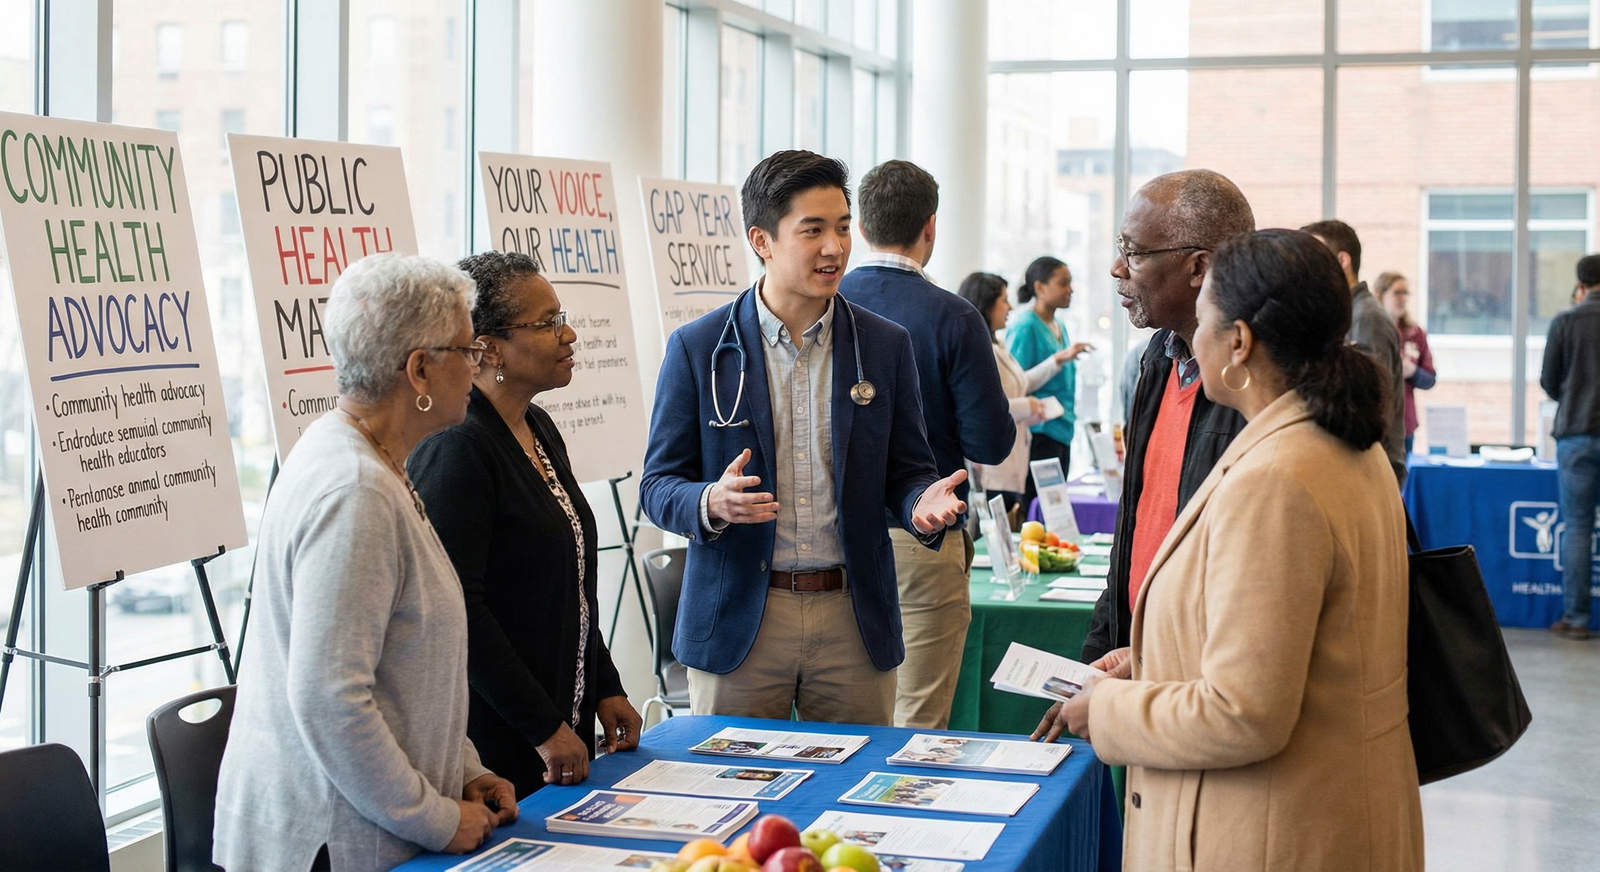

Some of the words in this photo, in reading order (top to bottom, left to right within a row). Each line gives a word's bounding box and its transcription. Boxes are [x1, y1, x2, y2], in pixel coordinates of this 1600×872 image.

[1, 129, 177, 214] COMMUNITY
[256, 150, 376, 216] PUBLIC
[488, 164, 548, 214] YOUR
[549, 169, 613, 223] VOICE,
[650, 188, 685, 234] GAP
[688, 191, 737, 238] YEAR
[45, 219, 170, 284] HEALTH
[549, 227, 620, 275] HEALTH
[668, 242, 737, 287] SERVICE
[48, 290, 192, 362] ADVOCACY
[52, 386, 118, 419] Community
[121, 382, 157, 408] health
[161, 380, 206, 406] advocacy
[57, 426, 114, 452] Endroduce
[162, 410, 213, 437] community
[79, 448, 115, 473] health
[118, 443, 167, 465] educators
[67, 483, 124, 508] Perntanose
[128, 471, 160, 494] animal
[163, 459, 217, 487] community
[76, 507, 112, 533] health
[115, 494, 169, 521] community
